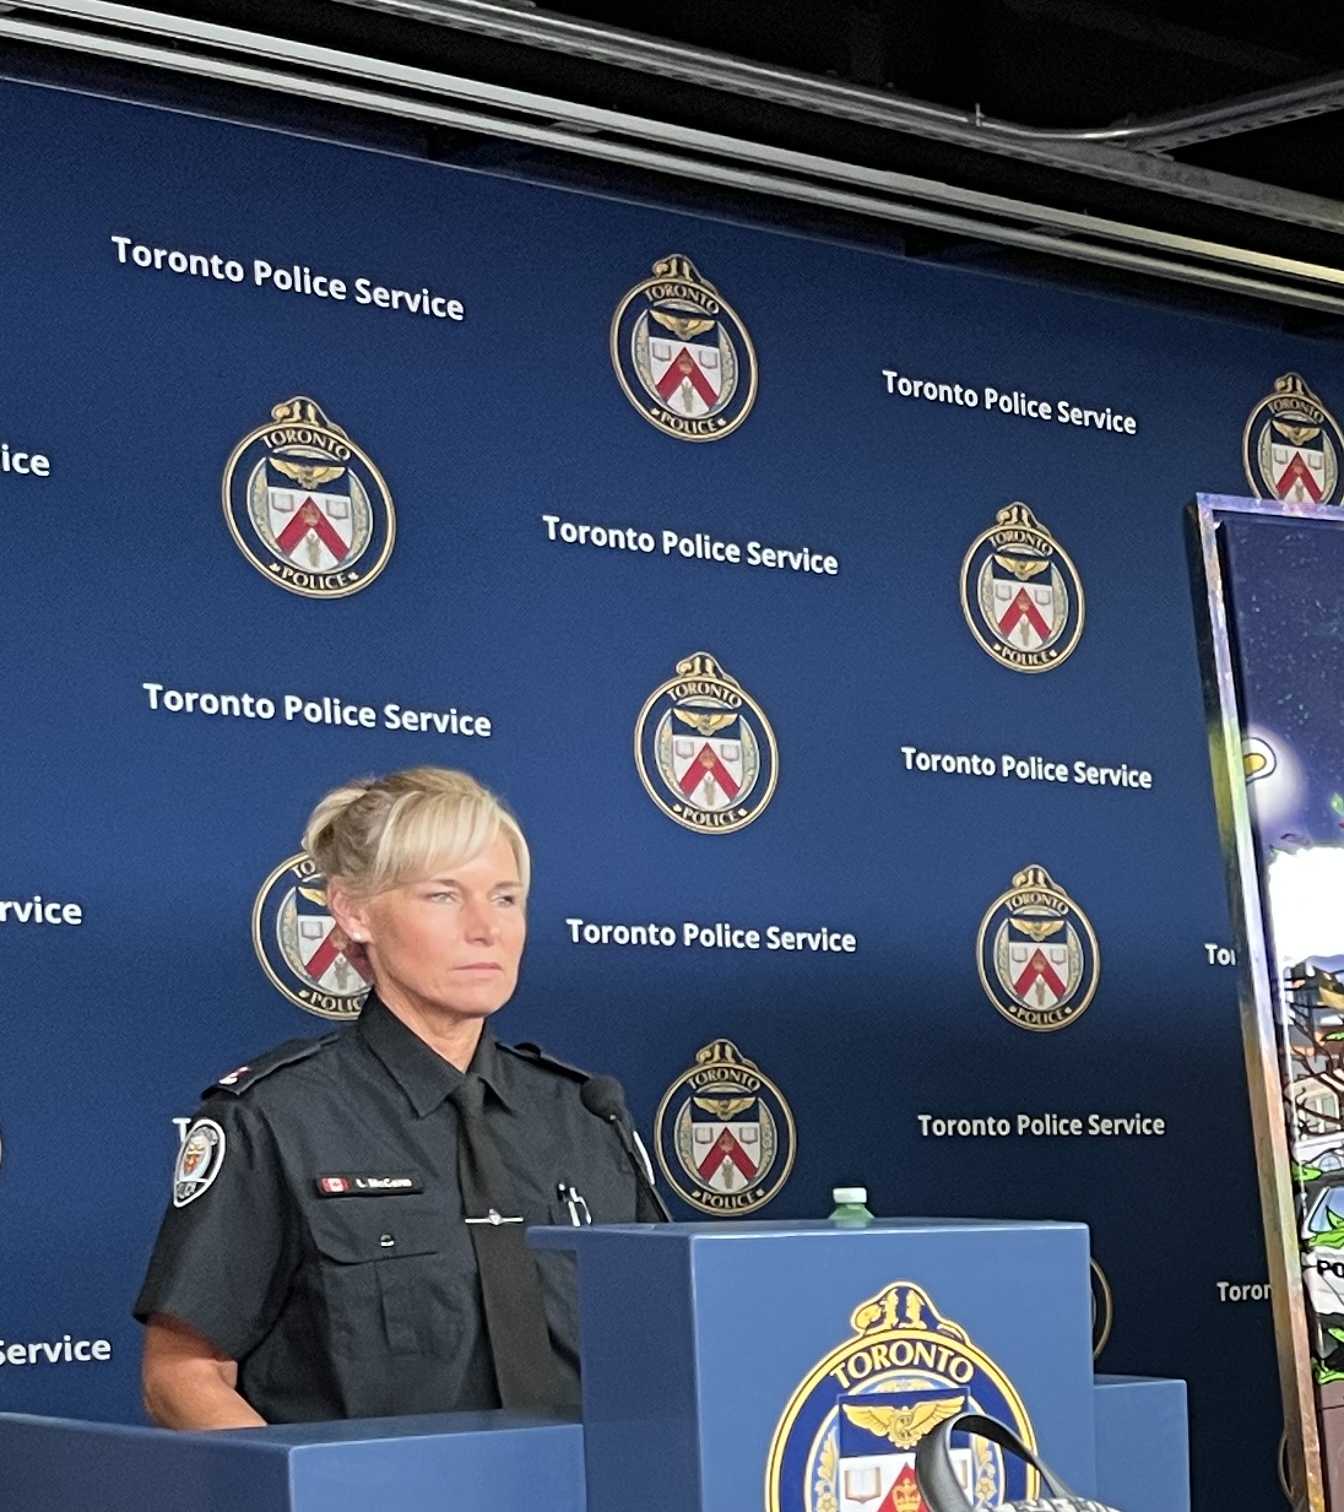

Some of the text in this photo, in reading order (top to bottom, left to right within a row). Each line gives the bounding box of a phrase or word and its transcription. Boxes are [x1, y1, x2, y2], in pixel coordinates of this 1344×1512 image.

[111, 235, 464, 320] Toronto Police Service
[644, 283, 719, 315] TORONTO
[881, 369, 1137, 435] Toronto Police Service
[660, 412, 716, 435] POLICE
[262, 428, 351, 462] TORONTO
[542, 514, 839, 575] Toronto Police Service
[988, 528, 1054, 557] TORONTO
[282, 568, 346, 591] POLICE
[1001, 647, 1049, 666] POLICE
[667, 681, 742, 709] TORONTO
[142, 682, 492, 737] Toronto Police Service
[900, 746, 1152, 789] Toronto Police Service
[682, 809, 739, 827] POLICE
[0, 895, 82, 925] rvice
[1005, 893, 1069, 916] TORONTO
[565, 918, 857, 952] Toronto Police Service
[311, 992, 366, 1011] POLIC
[1016, 1007, 1064, 1025] POLICE
[687, 1068, 761, 1091] TORONTO
[917, 1112, 1165, 1137] Toronto Police Service
[701, 1190, 757, 1209] POLICE
[830, 1340, 974, 1388] TORONTO
